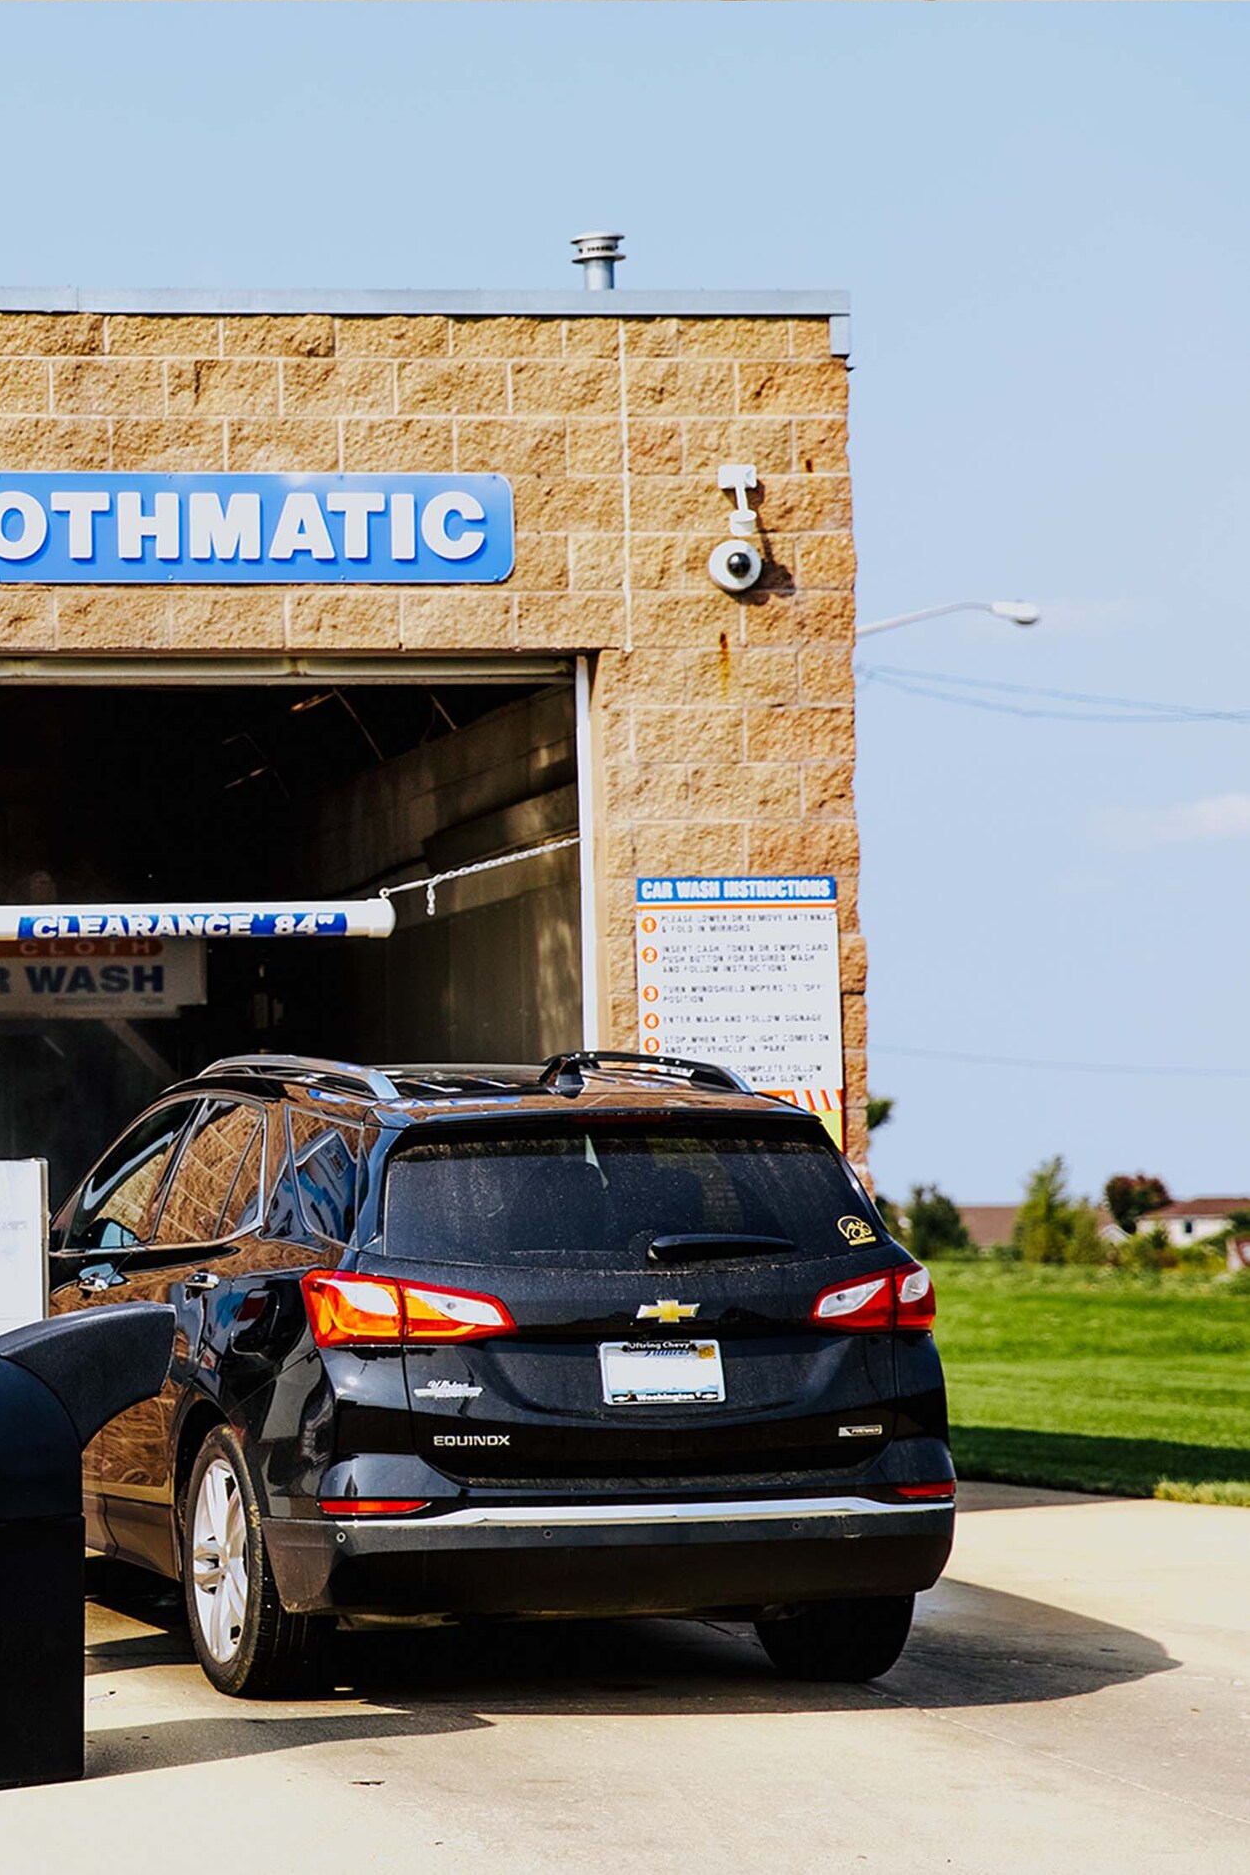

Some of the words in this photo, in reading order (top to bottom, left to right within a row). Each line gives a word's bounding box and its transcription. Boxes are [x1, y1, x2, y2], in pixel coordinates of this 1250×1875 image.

[642, 882, 673, 898] CAR
[676, 882, 720, 898] WASH
[723, 880, 831, 898] INSTRUCTIONS
[32, 916, 253, 938] CLEARANCE
[20, 941, 150, 956] CLOTH
[24, 965, 164, 993] WASH
[433, 1435, 510, 1446] EQUINOX
